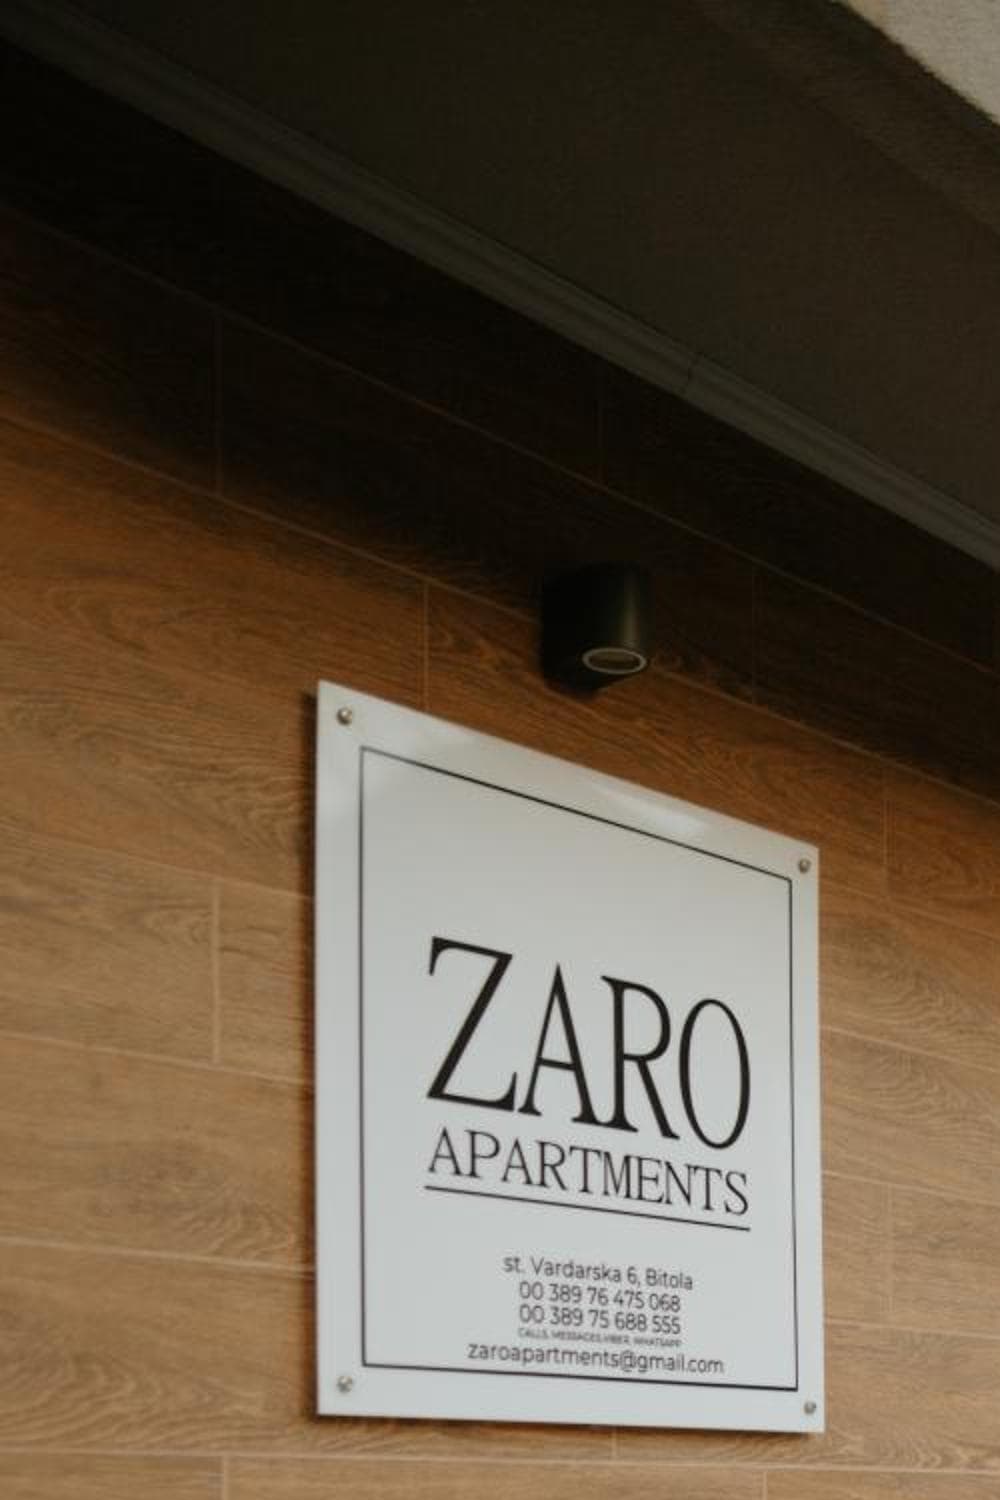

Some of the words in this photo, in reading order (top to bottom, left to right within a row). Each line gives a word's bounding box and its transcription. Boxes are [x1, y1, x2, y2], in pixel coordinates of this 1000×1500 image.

[427, 936, 750, 1149] ZARO
[428, 1126, 749, 1215] APARTMENTS
[529, 1256, 621, 1283] Vardarska
[646, 1267, 693, 1291] Bitola
[520, 1281, 544, 1301] 00
[549, 1283, 582, 1304] 389
[587, 1286, 609, 1306] 76
[613, 1289, 645, 1310] 475
[649, 1293, 681, 1313] 068
[519, 1303, 544, 1323] 00
[550, 1305, 583, 1327] 389
[588, 1308, 609, 1329] 75
[615, 1311, 648, 1332] 688
[652, 1315, 681, 1335] 555
[467, 1343, 725, 1373] zaroapartments@gmail.com
